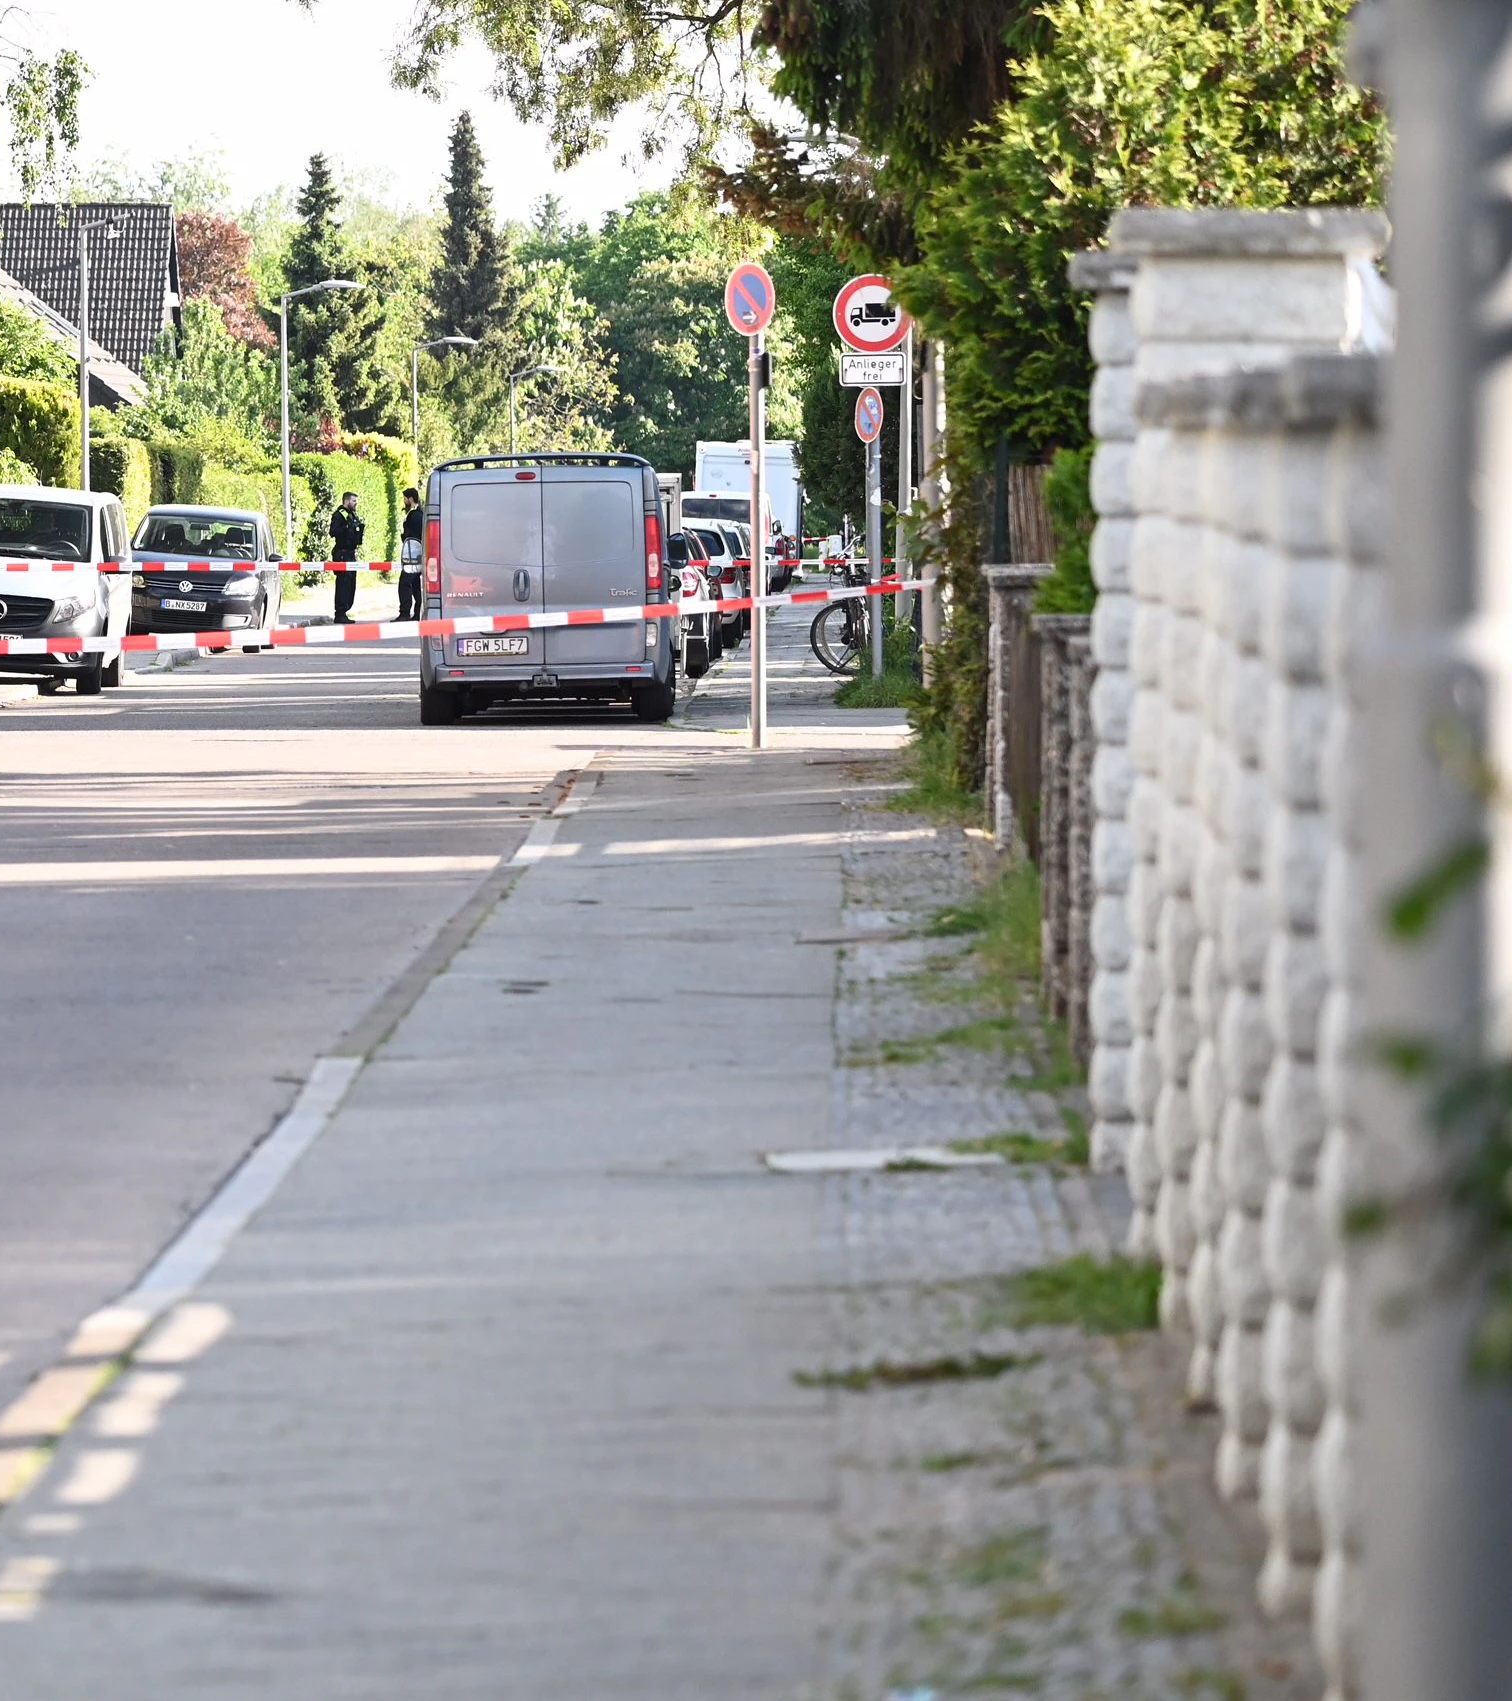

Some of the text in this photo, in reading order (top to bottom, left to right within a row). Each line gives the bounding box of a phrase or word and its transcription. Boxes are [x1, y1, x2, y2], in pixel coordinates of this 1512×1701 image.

[849, 359, 896, 371] Anlieger
[863, 371, 882, 380] frei
[610, 588, 638, 597] Trafic
[466, 638, 524, 652] FGW 5LF7
